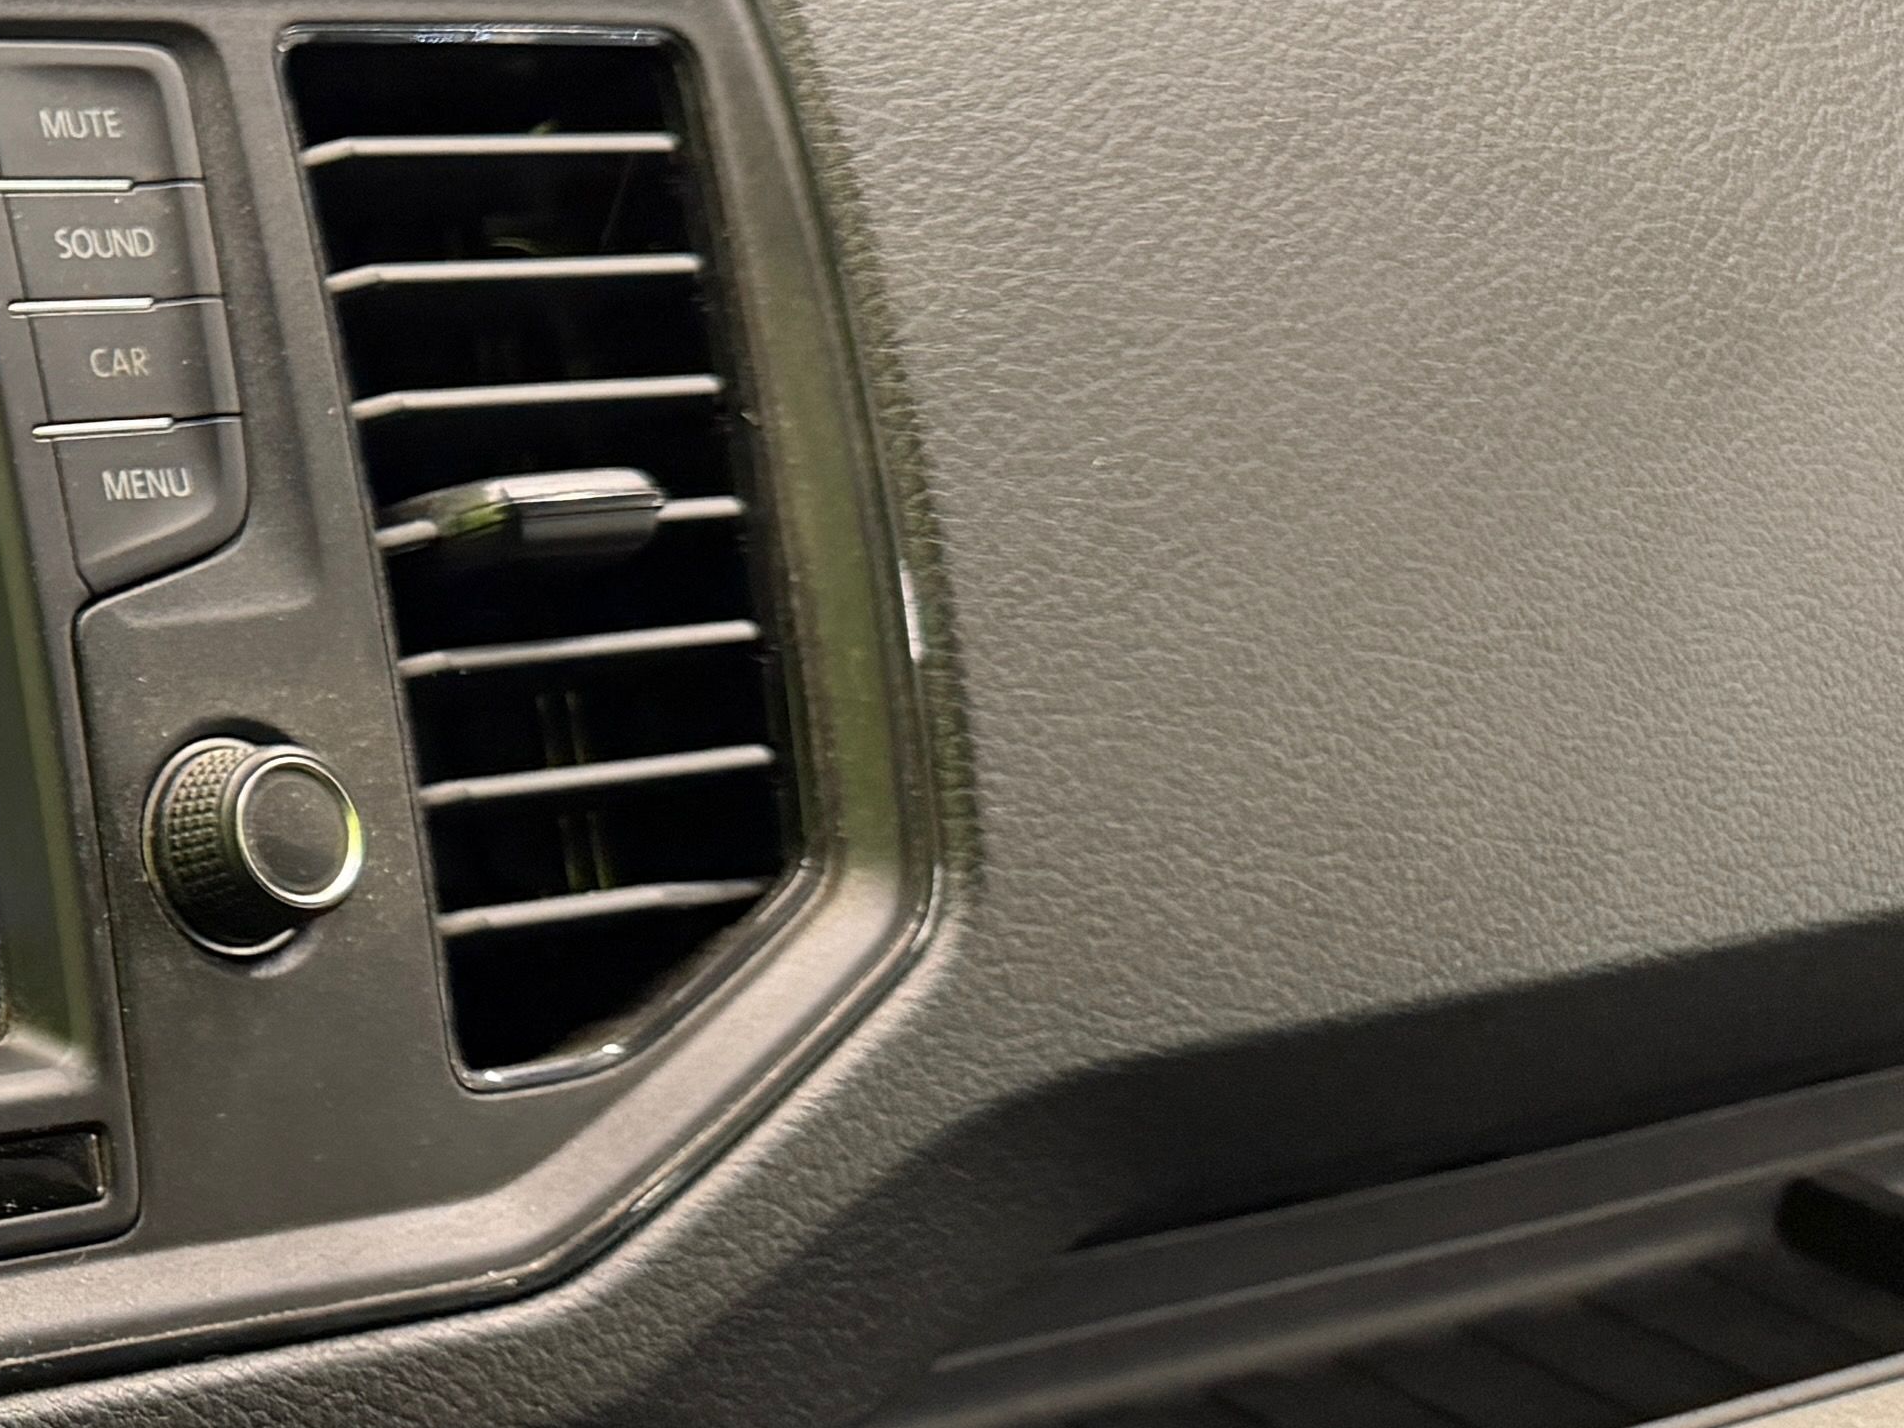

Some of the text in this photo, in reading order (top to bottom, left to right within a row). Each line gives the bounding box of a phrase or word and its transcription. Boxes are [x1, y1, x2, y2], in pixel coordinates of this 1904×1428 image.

[38, 108, 123, 140] MUTE
[53, 227, 155, 259] SOUND
[89, 348, 150, 378] CAR
[101, 468, 191, 502] MENU
